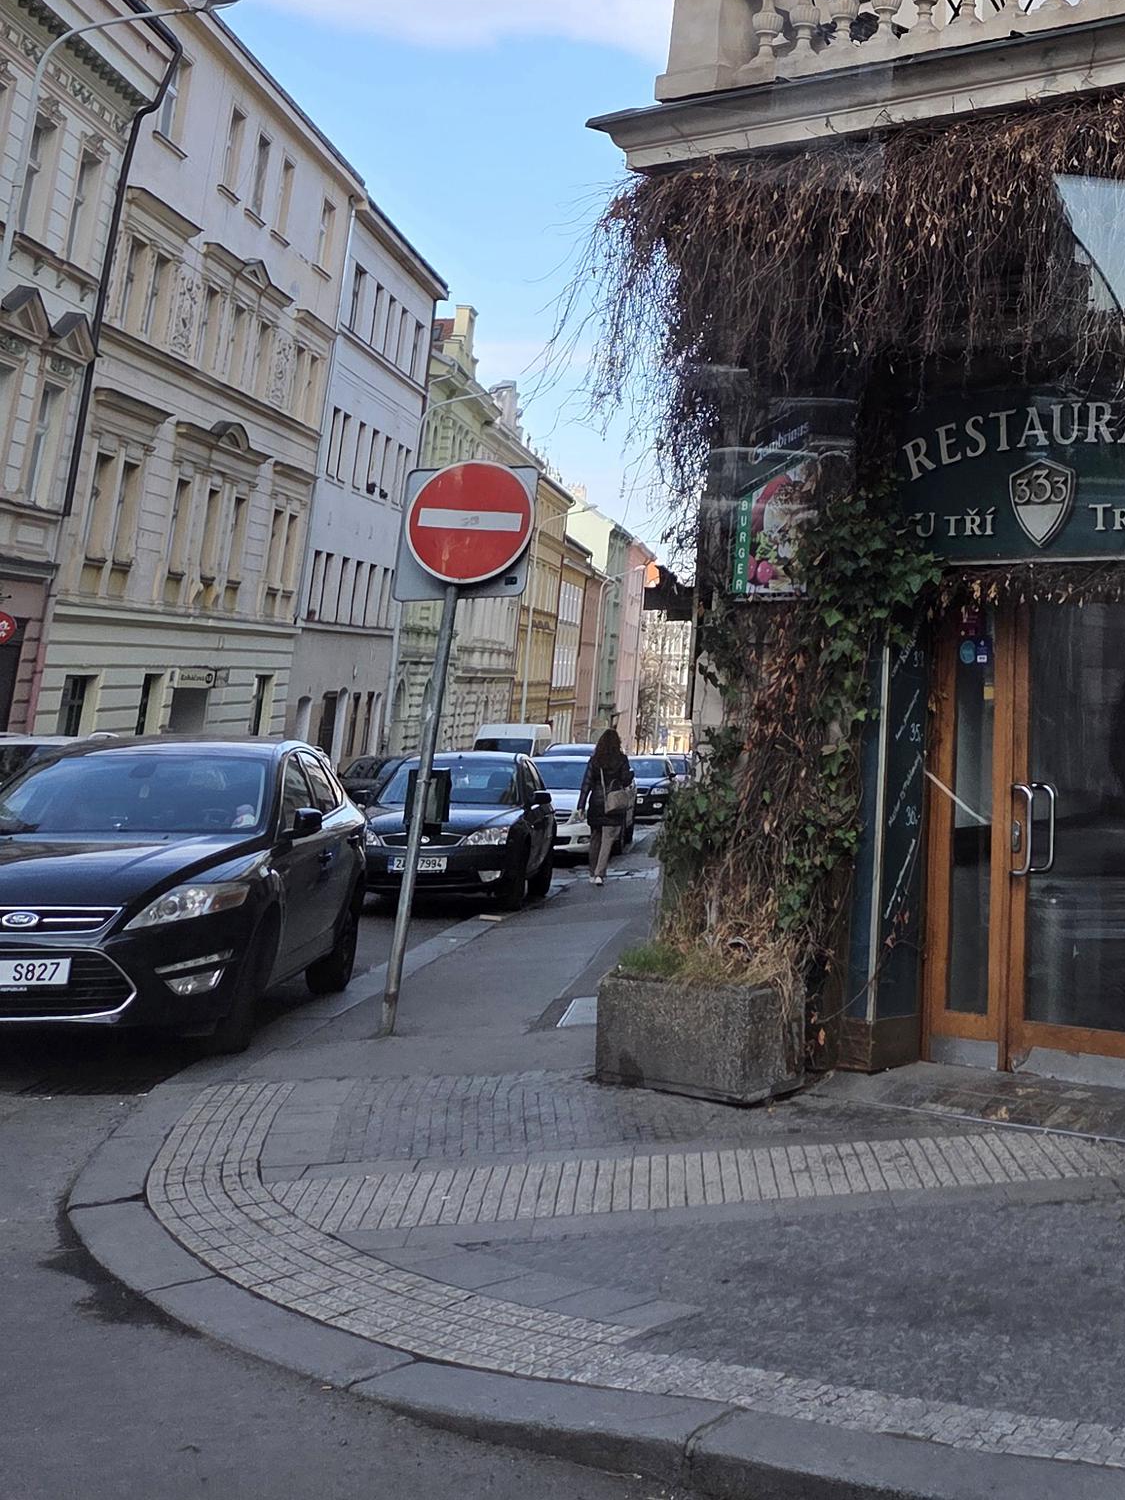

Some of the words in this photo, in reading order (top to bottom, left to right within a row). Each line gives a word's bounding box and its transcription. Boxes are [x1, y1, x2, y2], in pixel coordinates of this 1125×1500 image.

[1014, 468, 1067, 504] 333
[943, 506, 997, 537] TŘÍ
[735, 500, 749, 591] BURGER
[12, 962, 61, 982] S827
